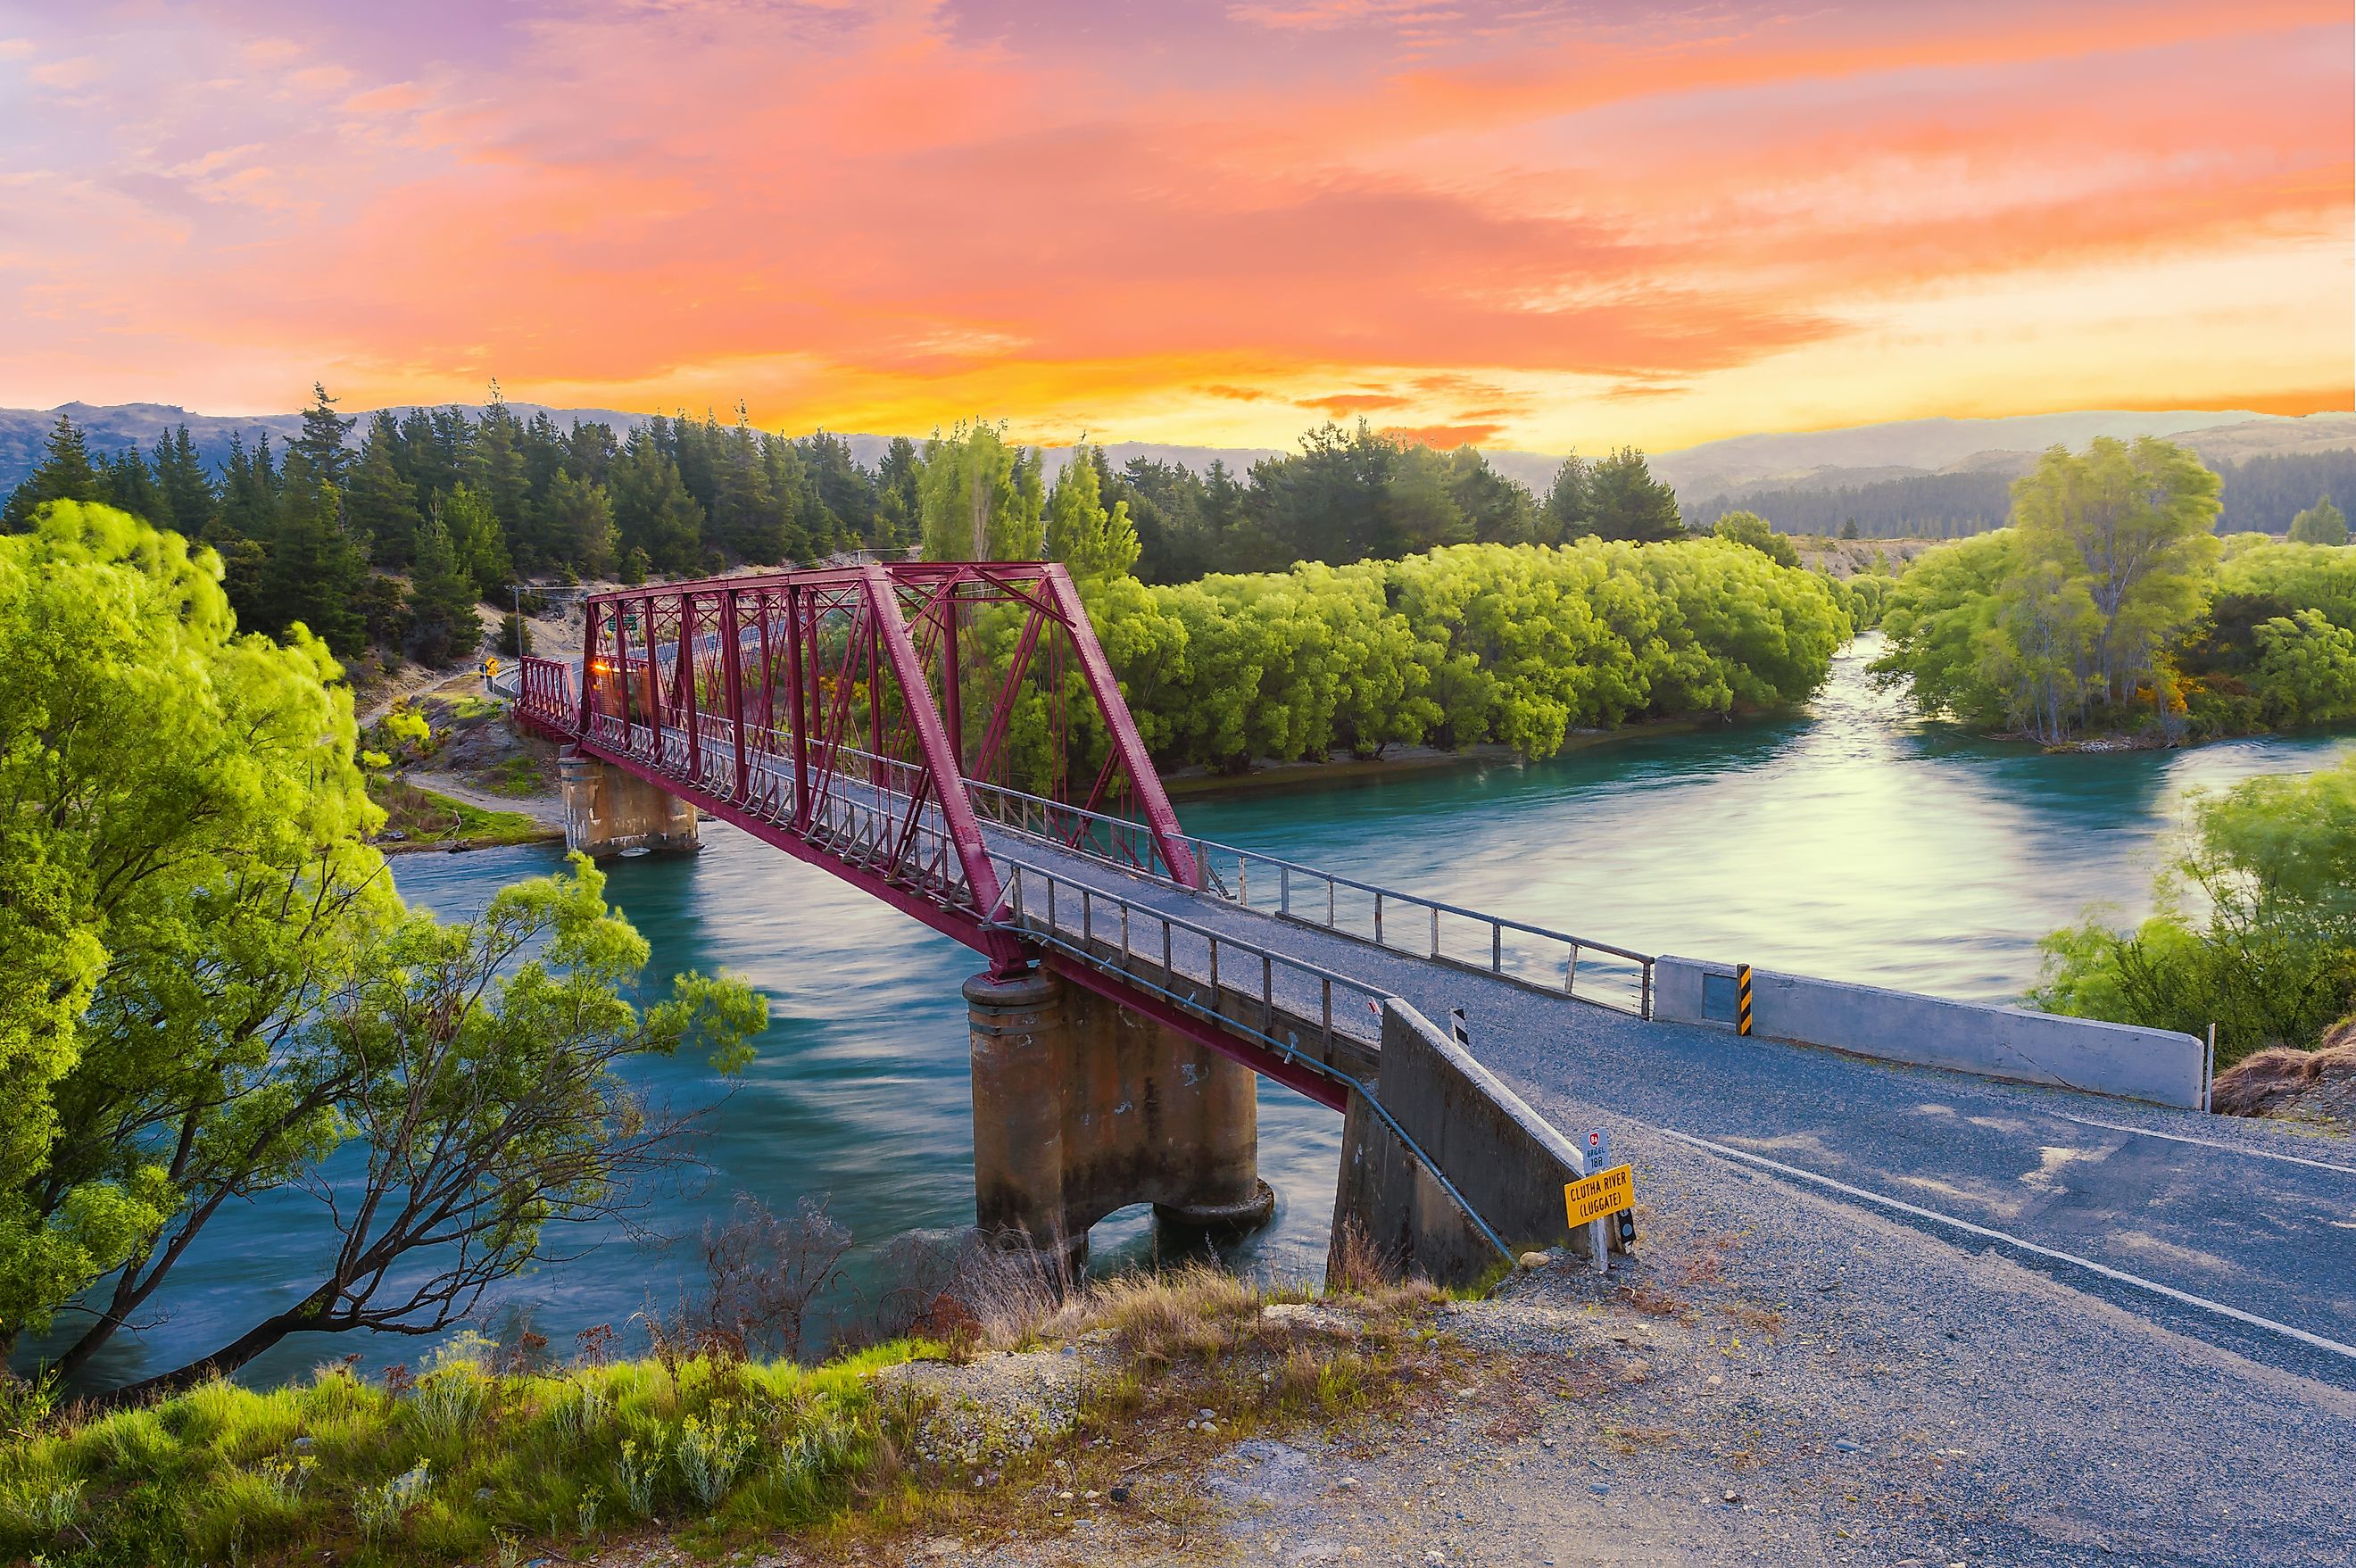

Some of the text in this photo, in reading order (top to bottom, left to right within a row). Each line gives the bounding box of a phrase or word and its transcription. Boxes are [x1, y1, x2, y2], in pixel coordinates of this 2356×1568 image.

[1591, 1157, 1602, 1168] 188
[1571, 1172, 1626, 1202] CLUTHA RIVER
[1580, 1192, 1621, 1217] (LUGGATE)
